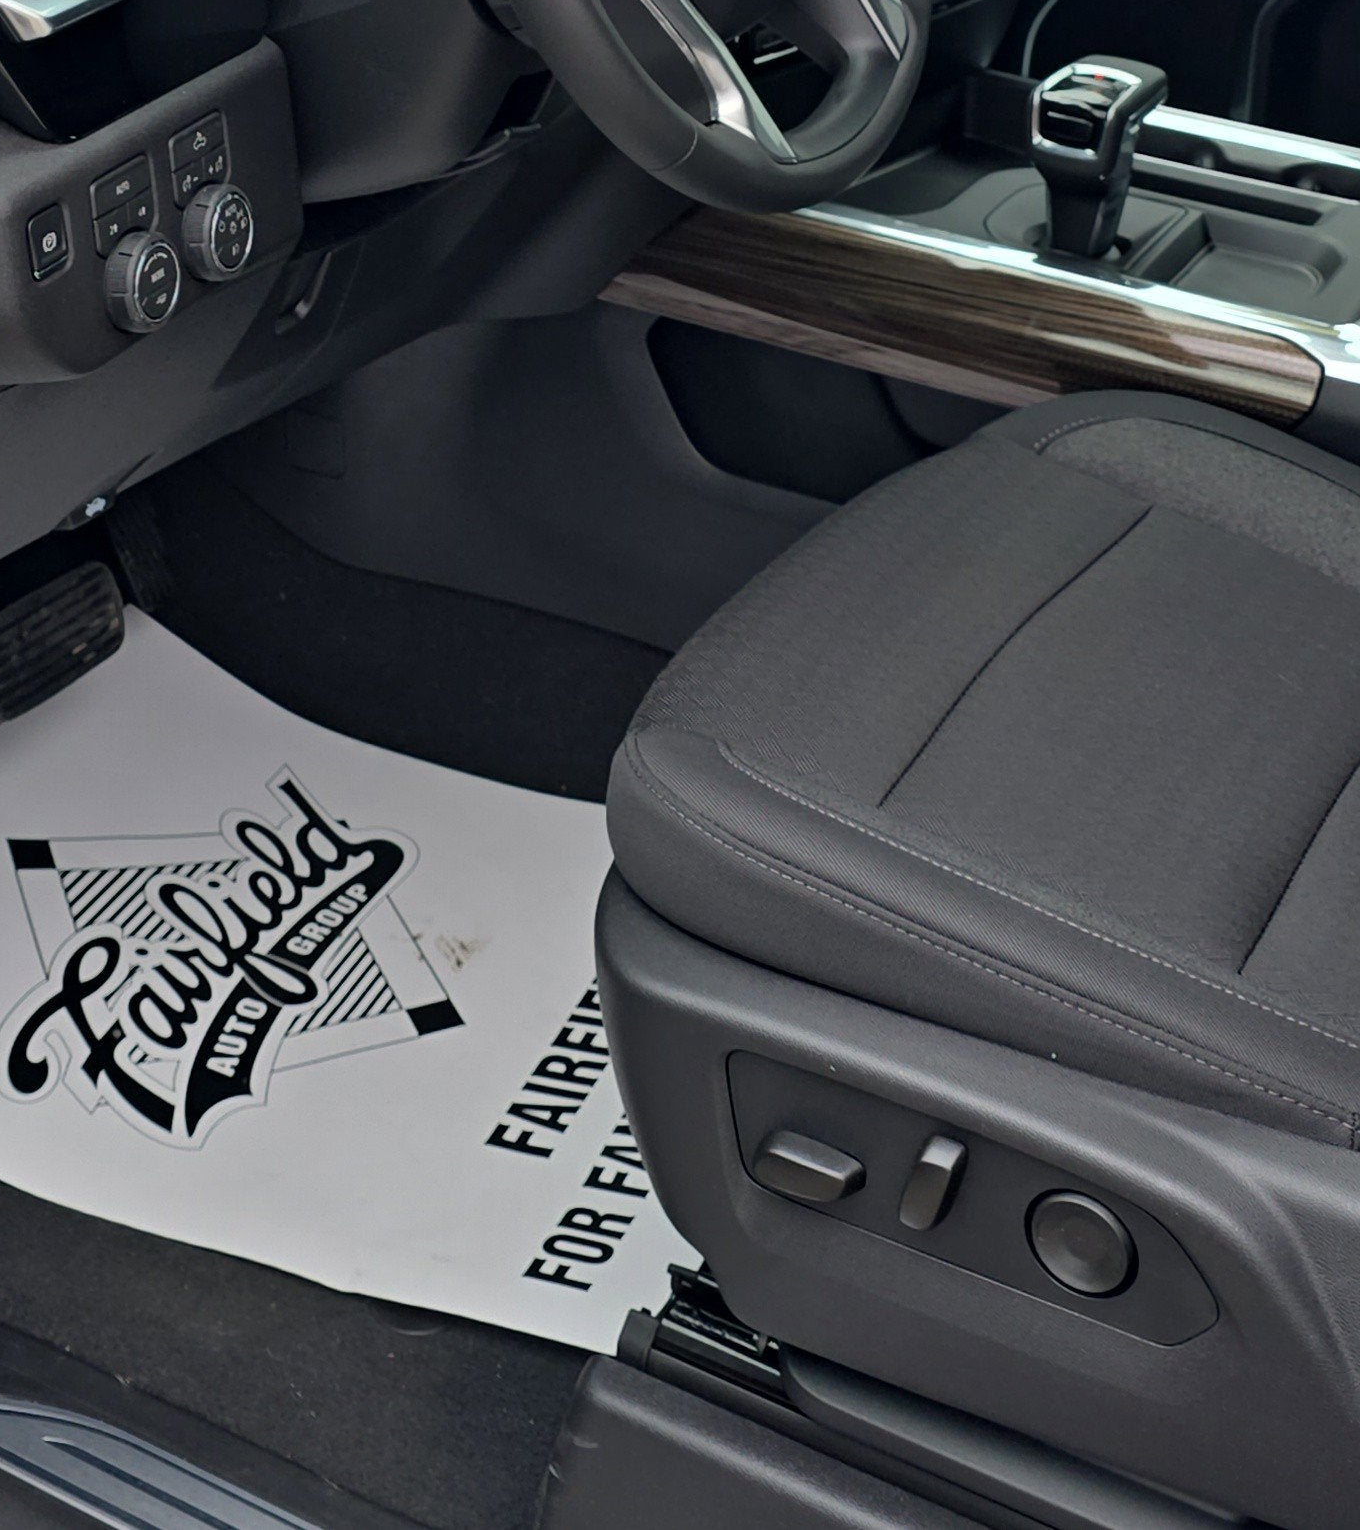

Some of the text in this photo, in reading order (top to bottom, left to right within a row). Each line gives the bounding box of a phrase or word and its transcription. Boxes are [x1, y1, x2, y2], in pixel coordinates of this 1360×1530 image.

[8, 780, 404, 1135] Fairfield
[205, 882, 370, 1078] AUTO GROUP
[521, 1206, 636, 1293] FOR
